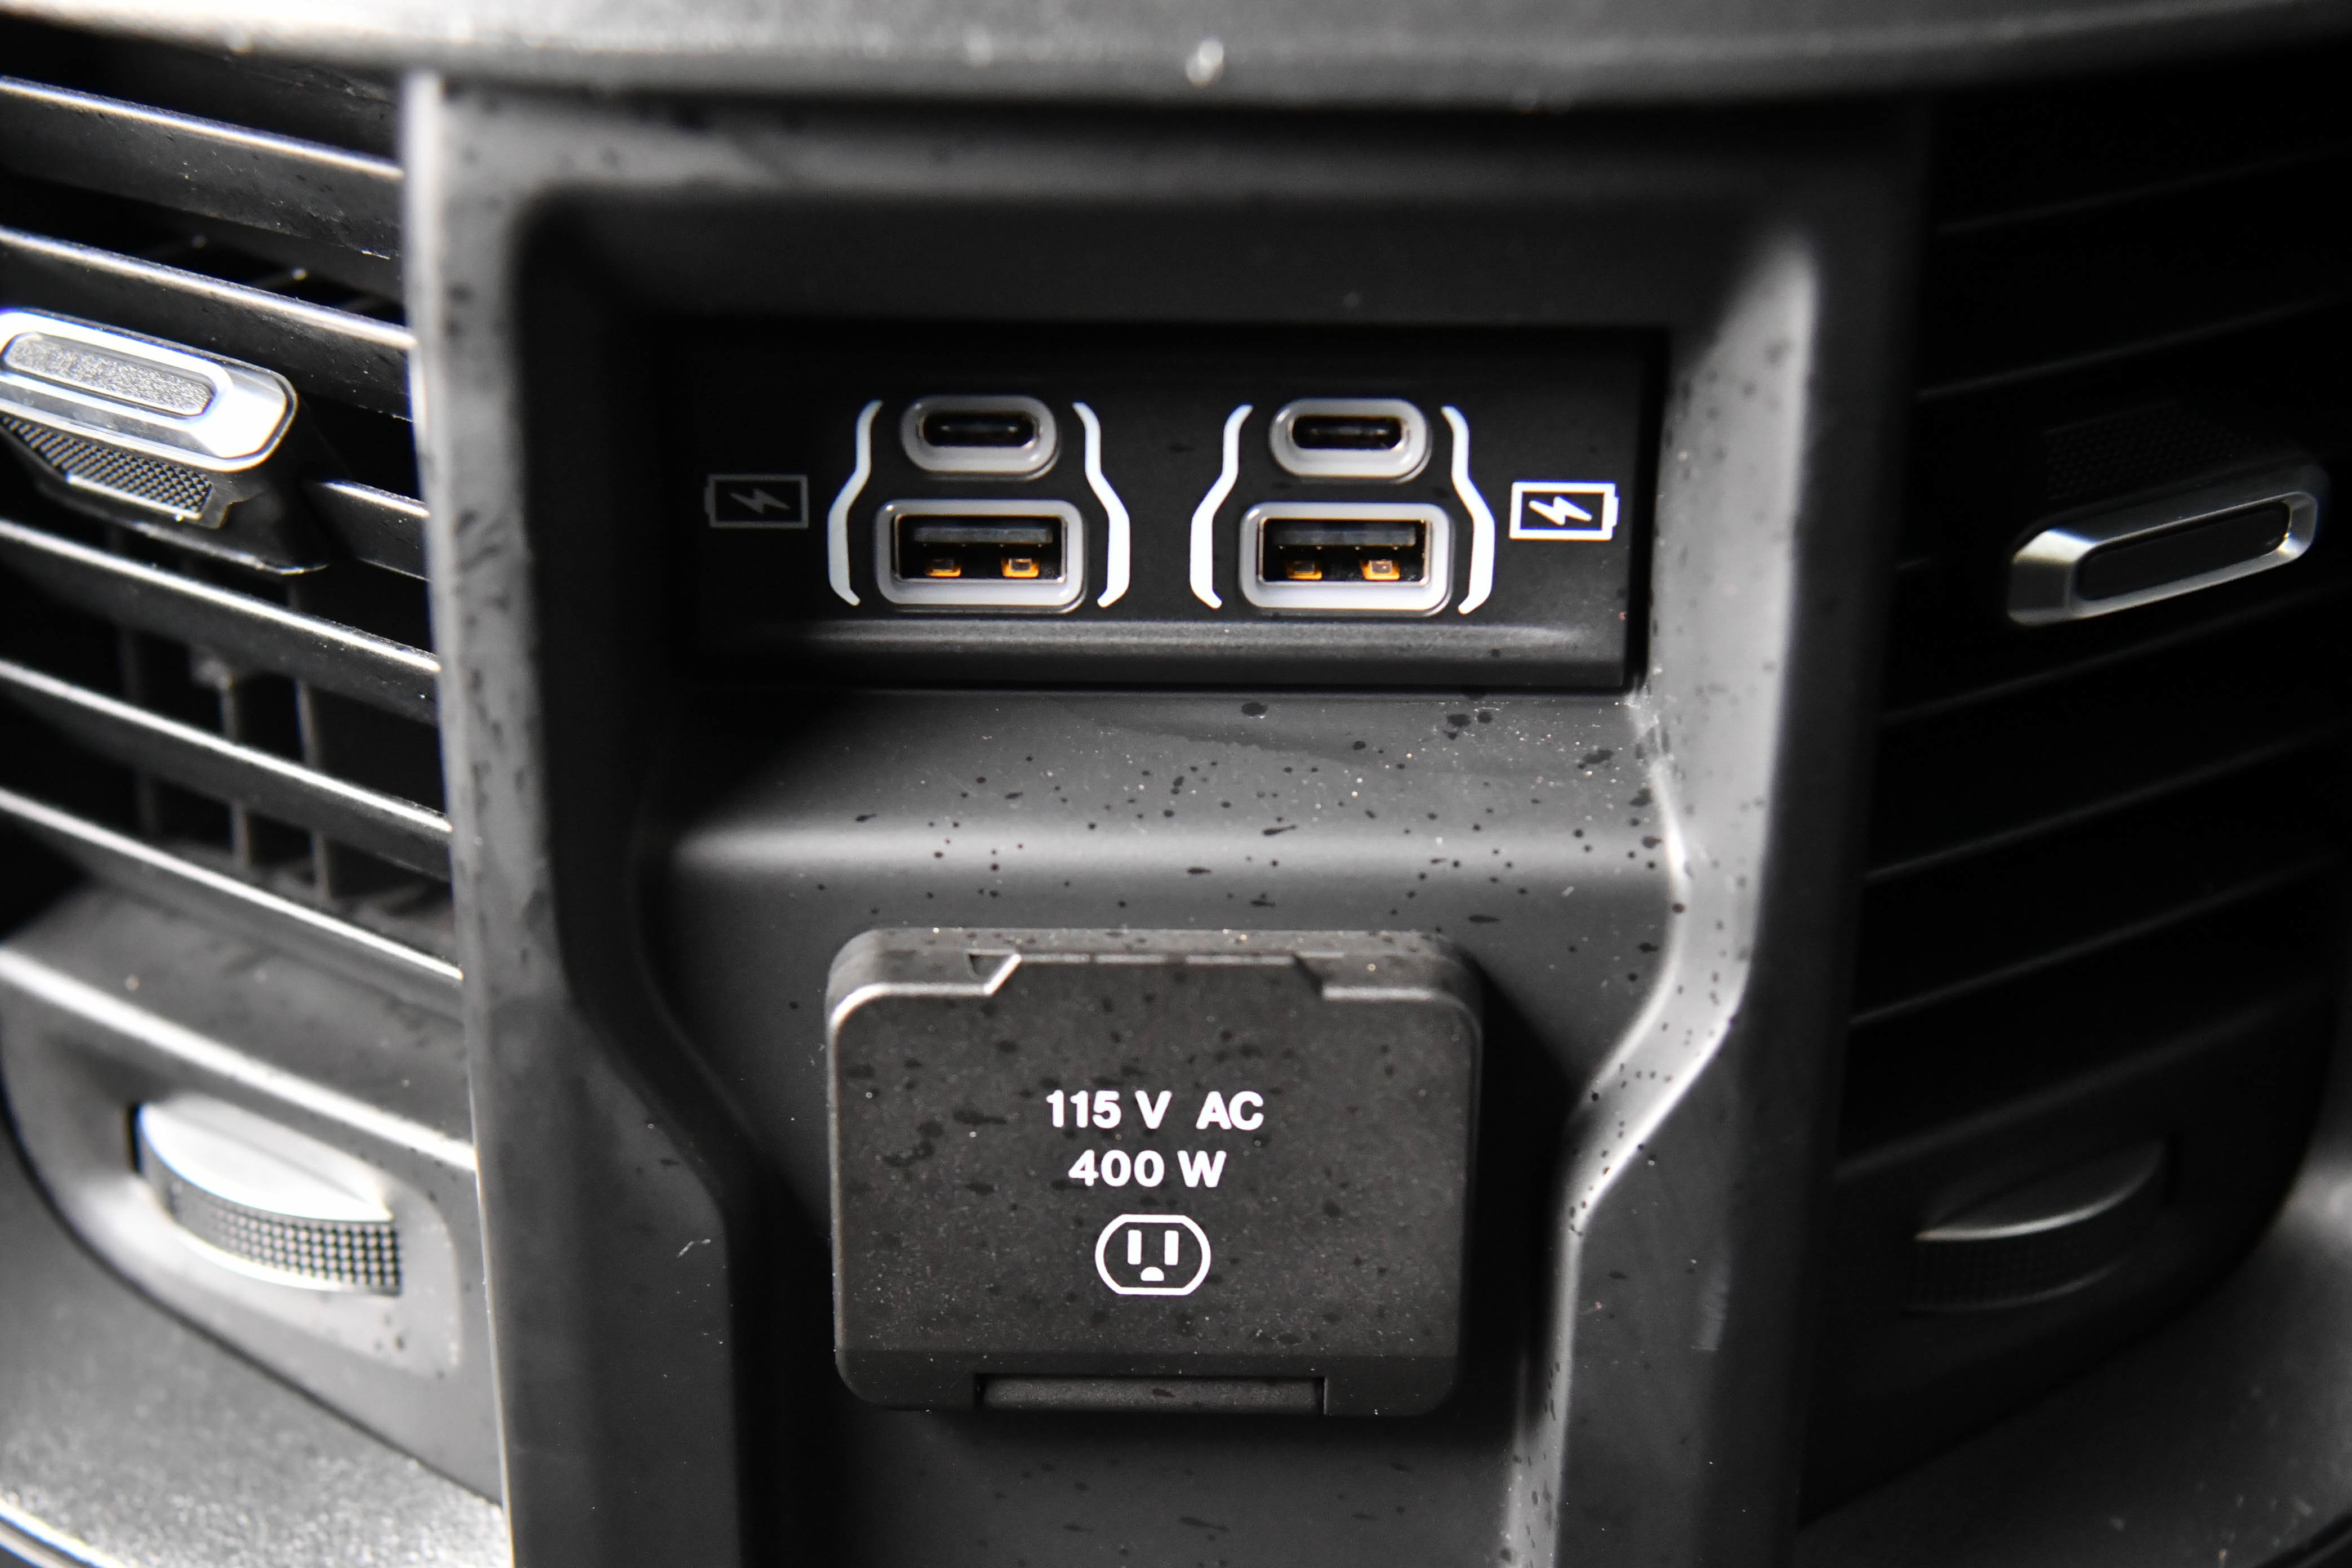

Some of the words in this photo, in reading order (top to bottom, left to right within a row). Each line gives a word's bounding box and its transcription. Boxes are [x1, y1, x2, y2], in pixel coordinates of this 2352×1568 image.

[1045, 1089, 1122, 1129] 115
[1134, 1090, 1173, 1130] V
[1195, 1090, 1264, 1131] AC
[1067, 1149, 1165, 1187] 400
[1177, 1150, 1227, 1188] W
